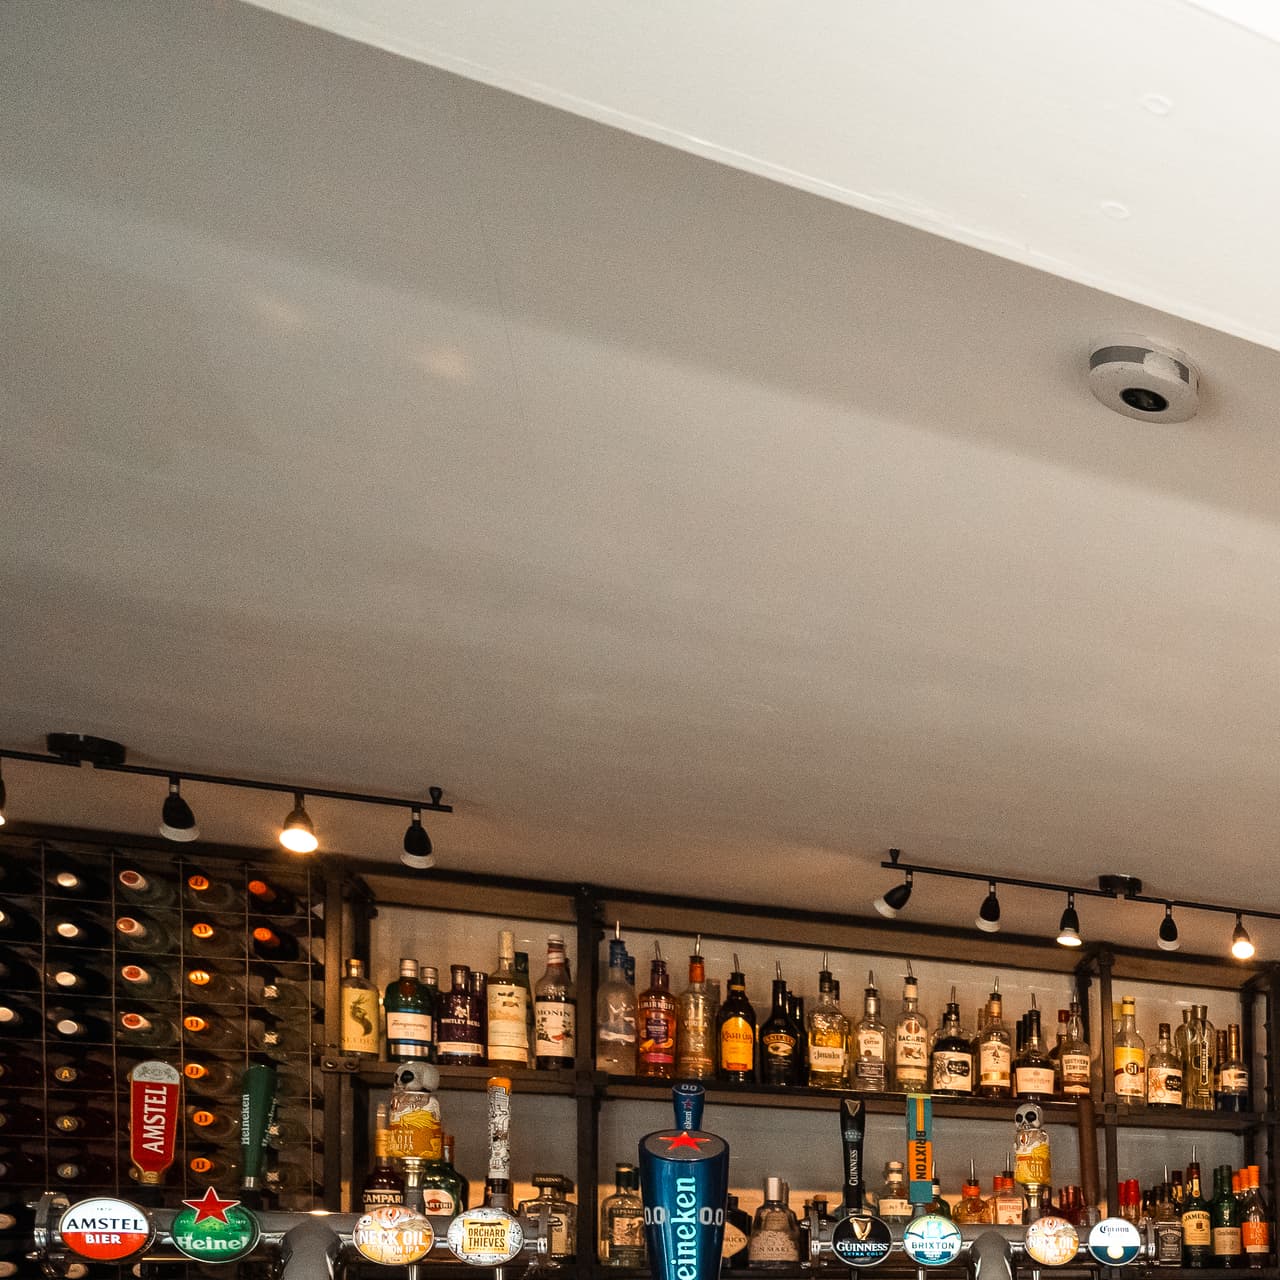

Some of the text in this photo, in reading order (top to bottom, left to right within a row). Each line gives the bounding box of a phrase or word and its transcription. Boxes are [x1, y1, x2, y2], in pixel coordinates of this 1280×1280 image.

[1127, 1063, 1138, 1075] 51
[142, 1085, 168, 1155] AMSTEL
[241, 1093, 250, 1146] Heineken
[915, 1130, 927, 1181] BRIXTON
[848, 1149, 859, 1187] GUINNESS
[362, 1193, 404, 1204] CAMPARI
[425, 1201, 453, 1209] ARTINI
[644, 1206, 666, 1226] 0.0
[699, 1206, 724, 1226] 0.0
[66, 1217, 143, 1231] AMSTEL
[1099, 1225, 1130, 1234] Corona
[85, 1233, 122, 1245] BIER
[359, 1230, 427, 1246] NECK OIL
[468, 1227, 506, 1239] ORCHARD
[468, 1237, 506, 1249] THIEVES
[836, 1241, 889, 1252] GUINNESS
[911, 1241, 955, 1250] BRIXTON
